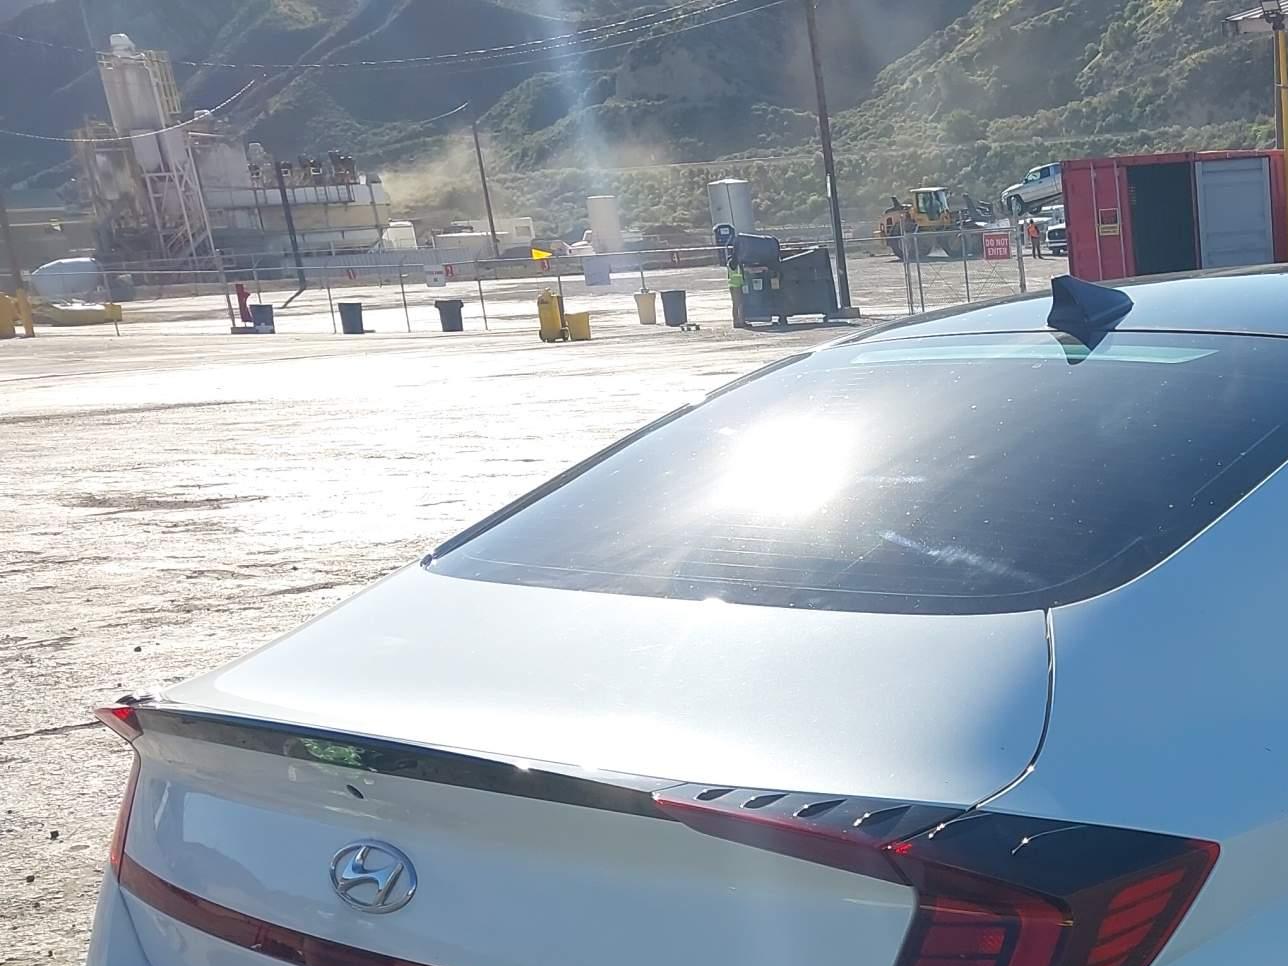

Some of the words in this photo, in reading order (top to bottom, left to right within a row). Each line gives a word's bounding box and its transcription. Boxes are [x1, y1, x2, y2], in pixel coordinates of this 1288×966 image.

[985, 239, 995, 247] DO
[996, 238, 1009, 247] NOT
[987, 247, 1008, 256] ENTER
